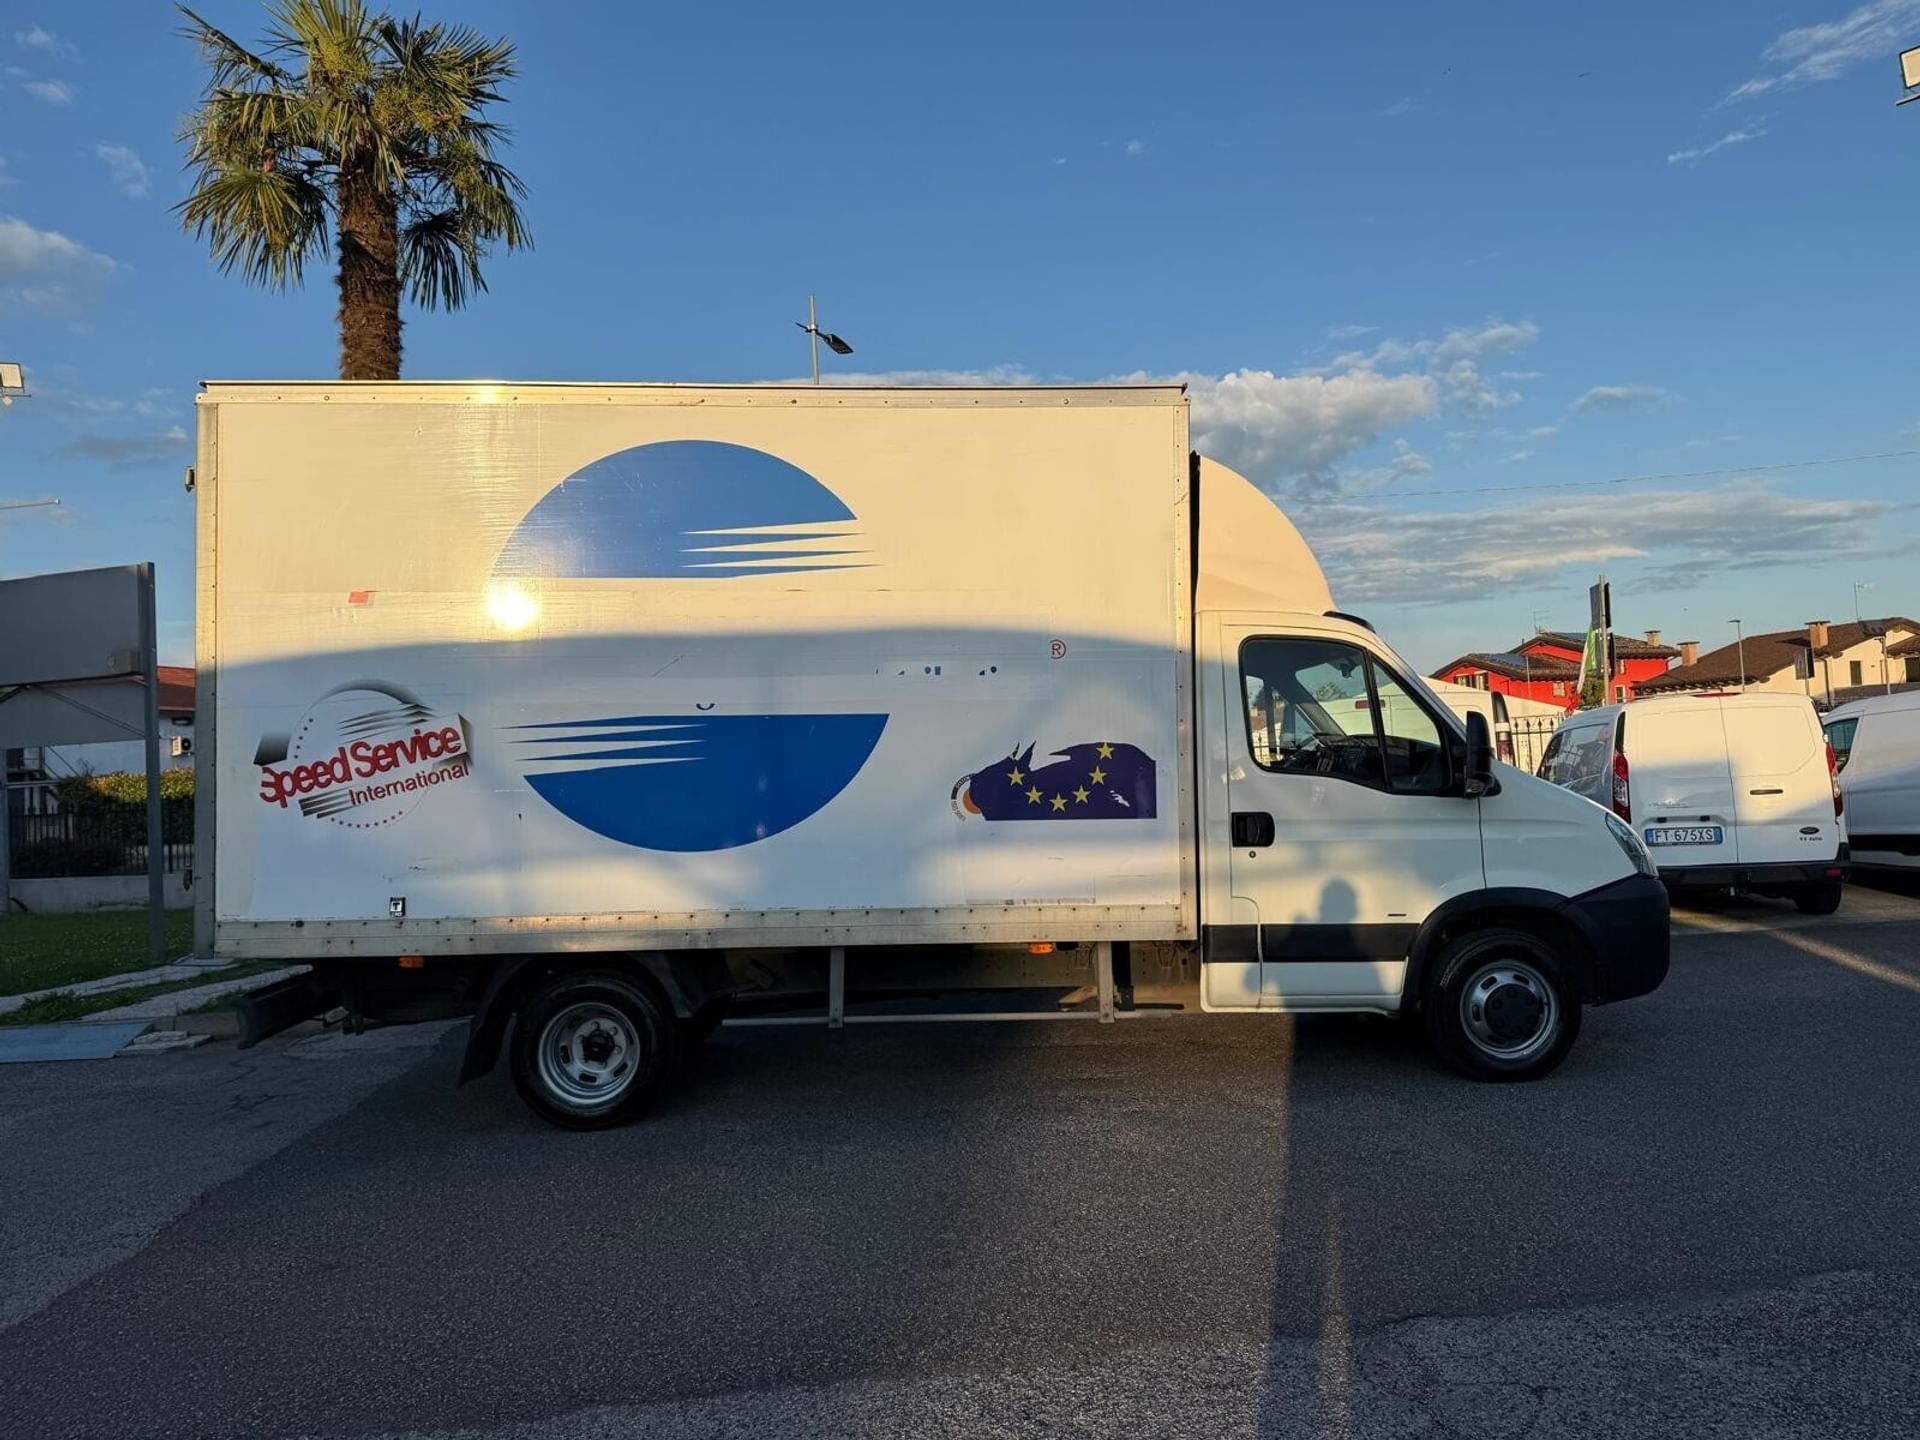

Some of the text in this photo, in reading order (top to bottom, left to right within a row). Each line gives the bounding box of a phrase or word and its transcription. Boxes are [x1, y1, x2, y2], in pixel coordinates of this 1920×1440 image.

[259, 727, 461, 808] Speed Service
[348, 761, 470, 806] International
[1655, 828, 1713, 842] FT 675XS
